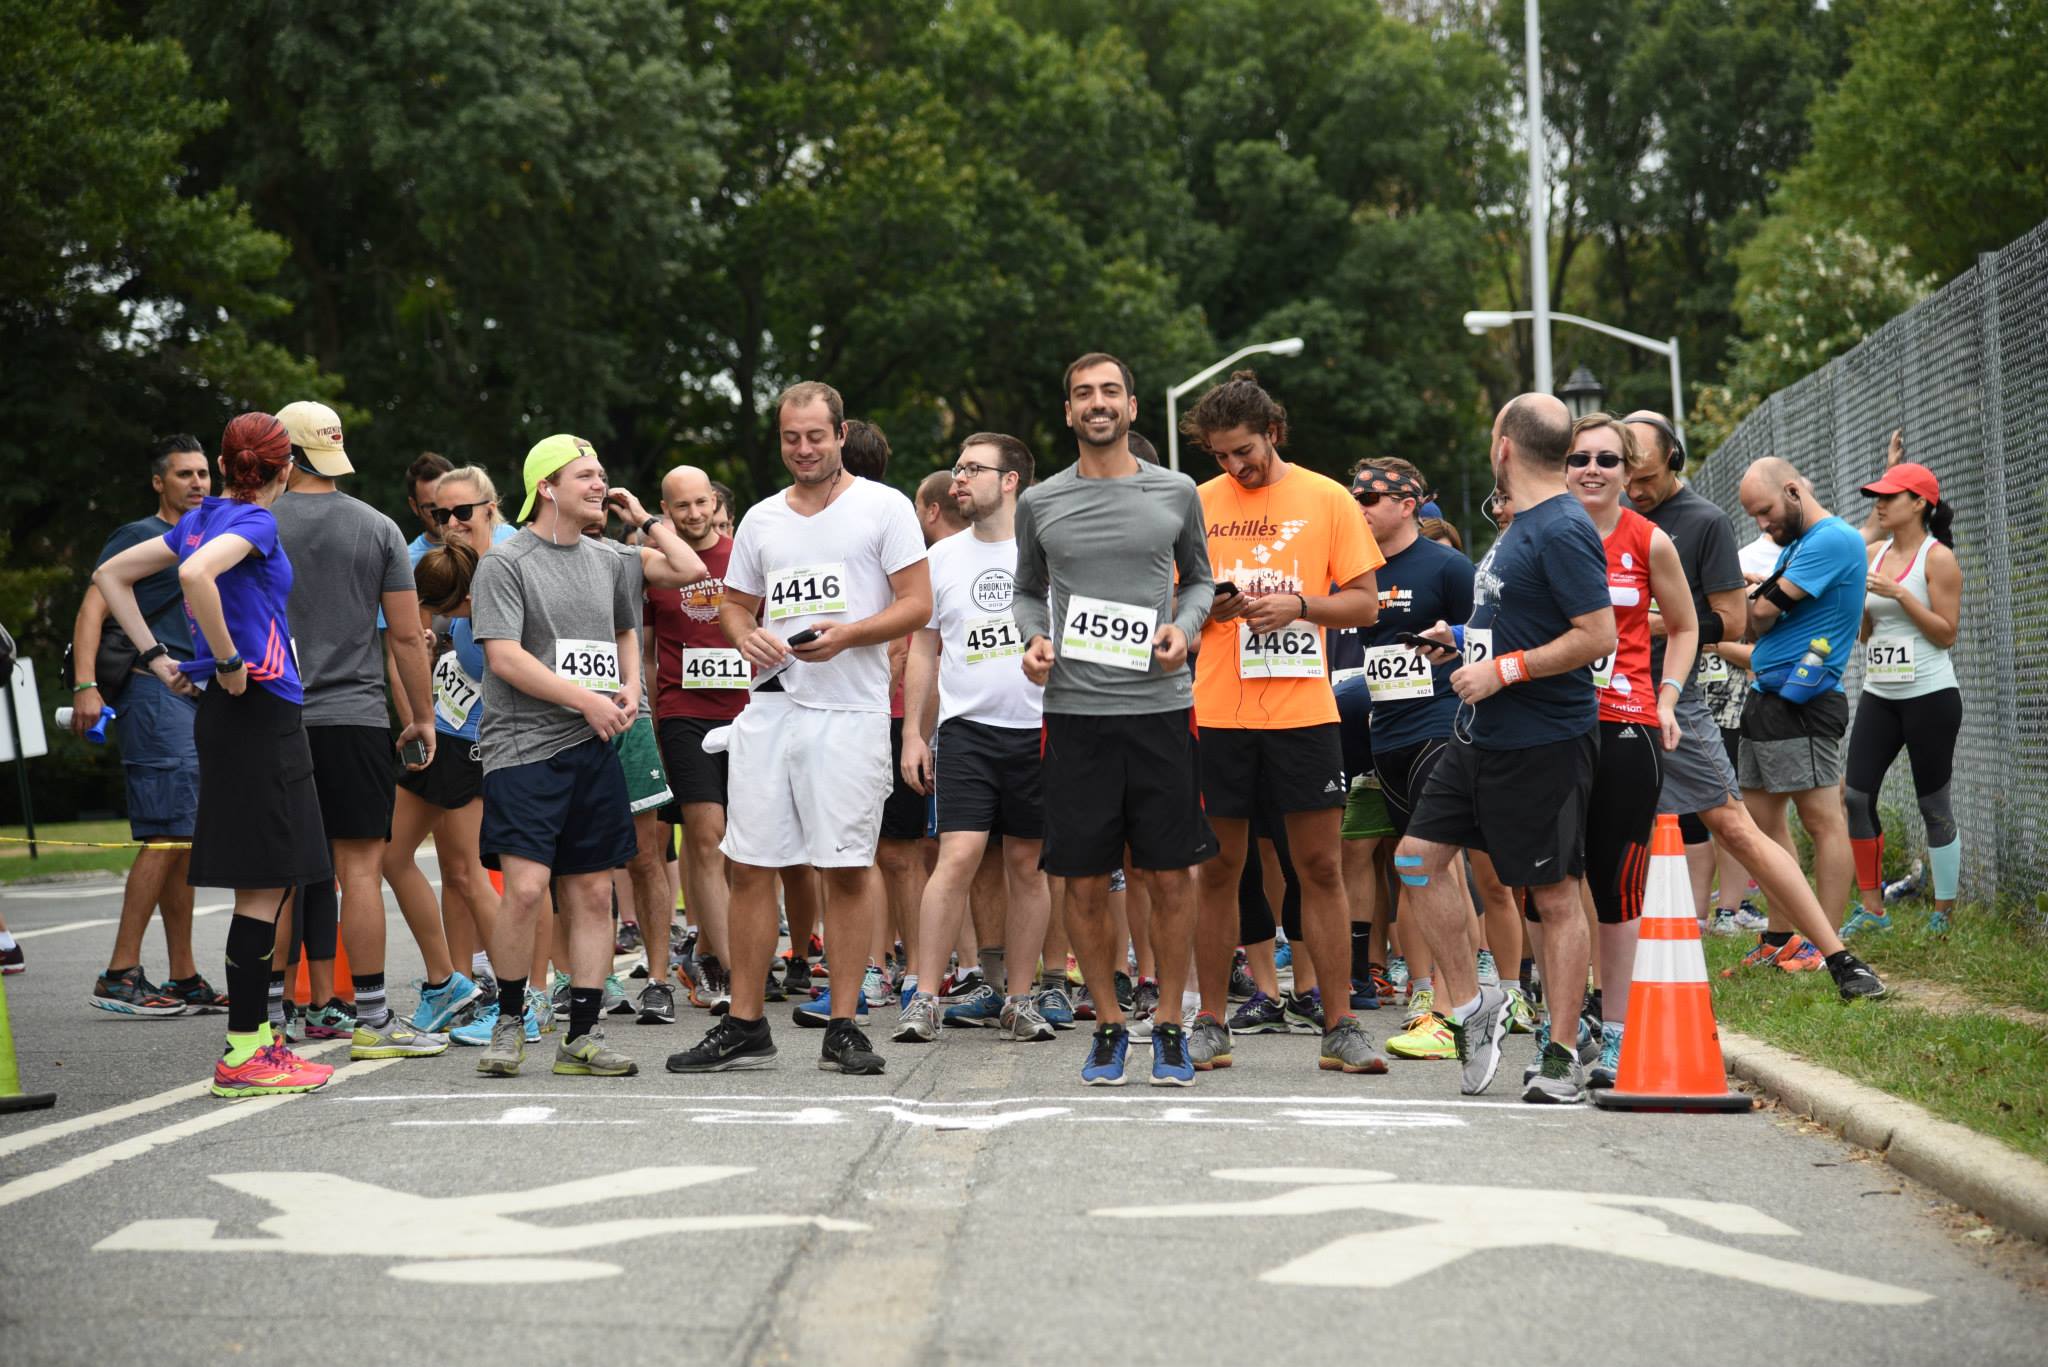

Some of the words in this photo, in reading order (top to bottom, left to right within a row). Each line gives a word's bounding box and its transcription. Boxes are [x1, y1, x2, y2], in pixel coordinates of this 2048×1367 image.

[1208, 520, 1277, 538] Achilles
[771, 575, 840, 604] 4416
[979, 582, 1012, 592] BROOKLYN
[979, 591, 1012, 600] HALF
[1070, 612, 1148, 645] 4599
[1245, 631, 1317, 655] 4462
[561, 652, 616, 678] 4363
[686, 659, 748, 678] 4611
[1366, 656, 1426, 681] 4624
[1868, 647, 1911, 666] 4571
[436, 661, 476, 707] 4377
